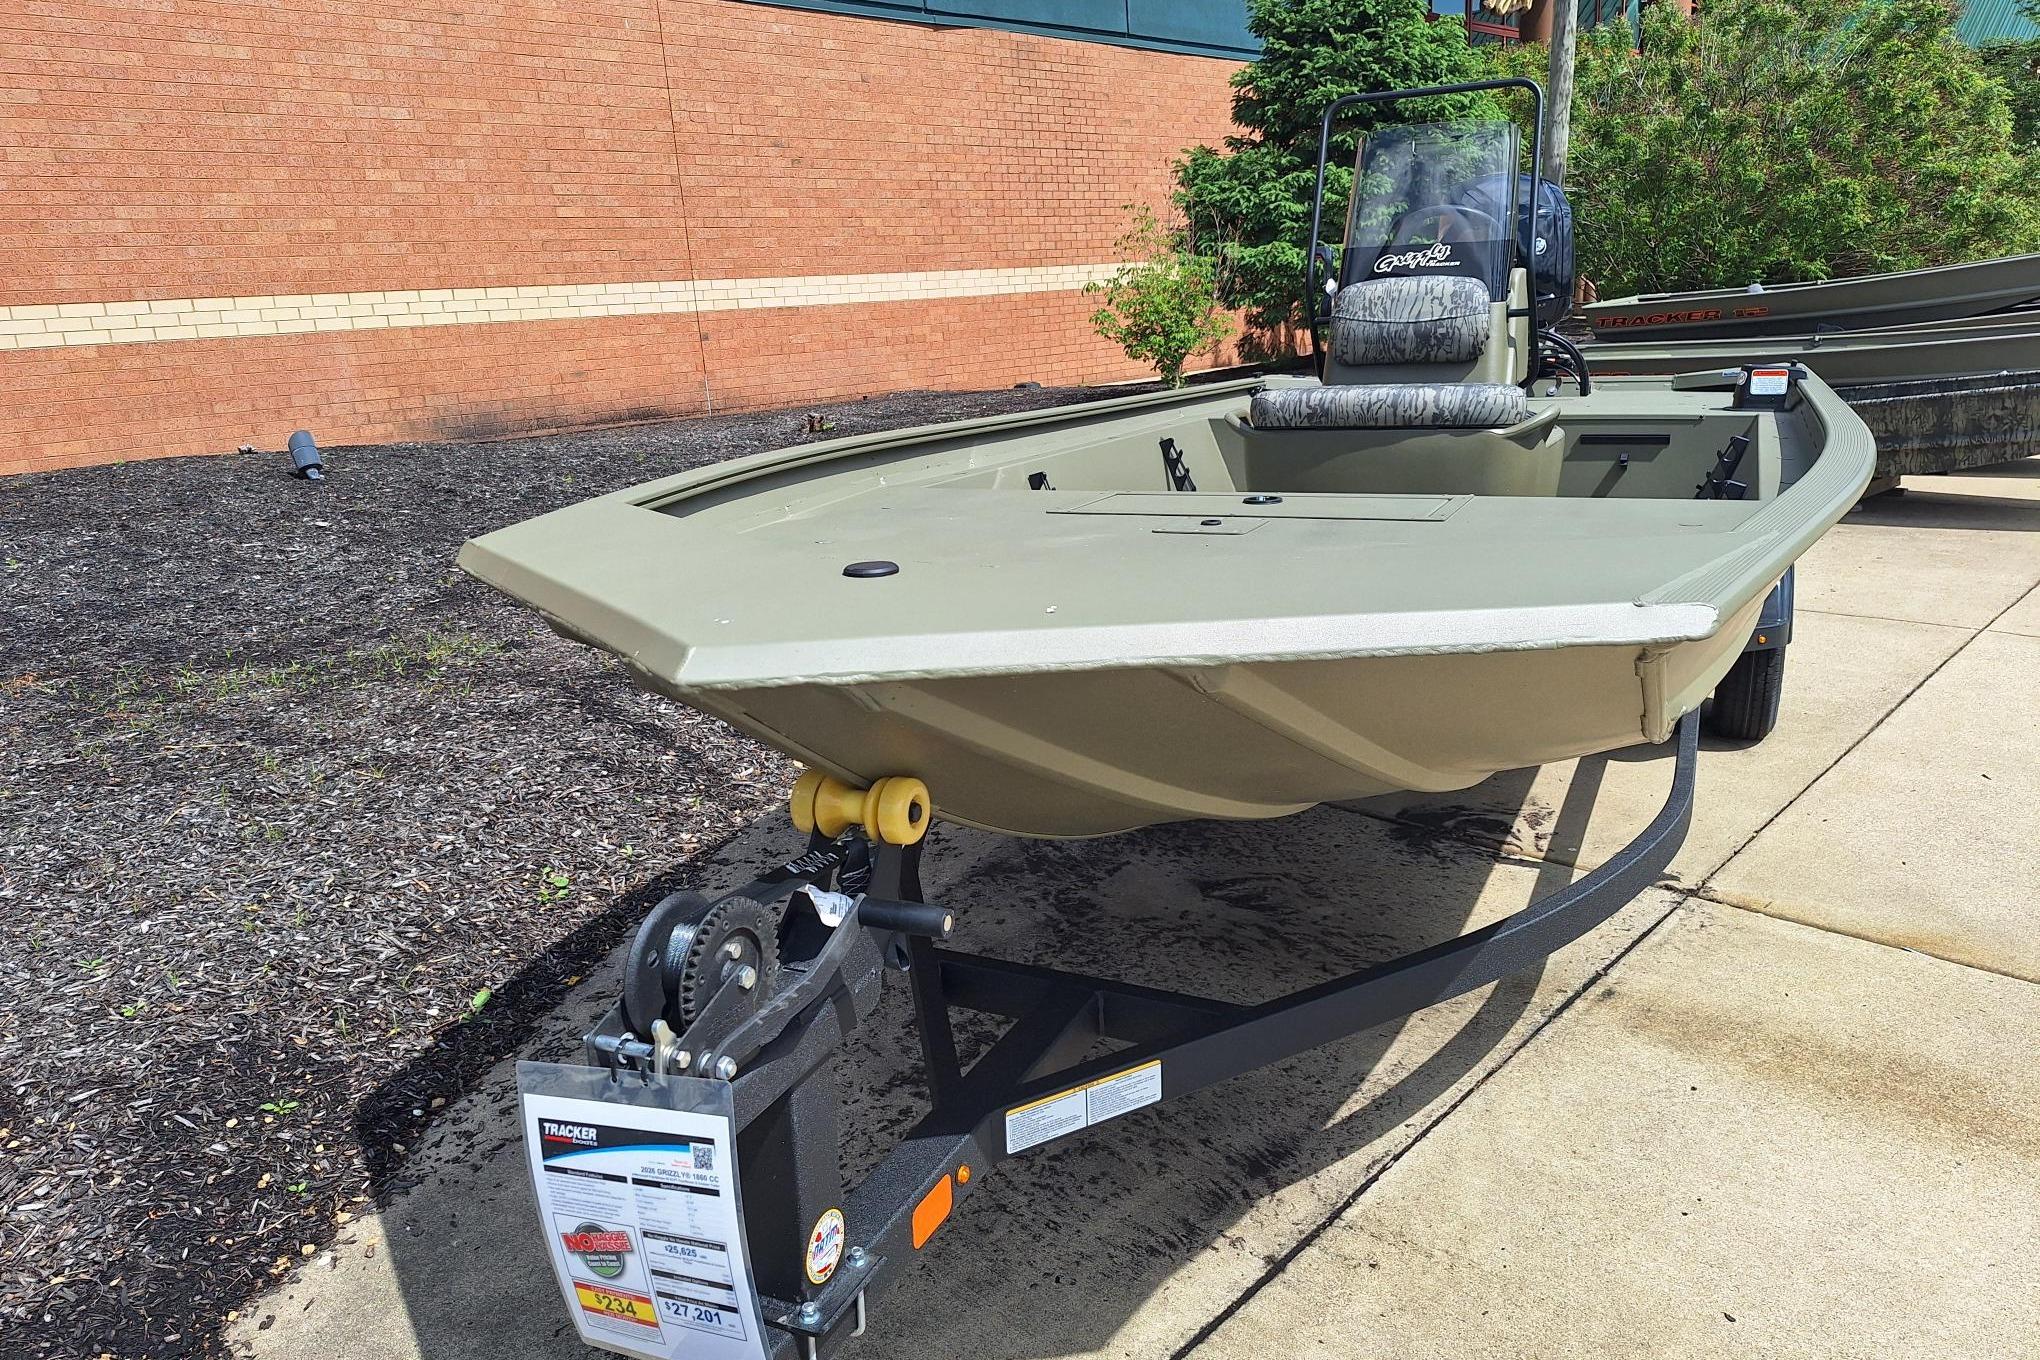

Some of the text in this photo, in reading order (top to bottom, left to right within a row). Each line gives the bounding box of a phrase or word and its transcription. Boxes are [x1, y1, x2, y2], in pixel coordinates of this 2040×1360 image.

[1596, 309, 1722, 328] TRACKER
[543, 1122, 597, 1140] TRACKER
[572, 1138, 598, 1147] boats
[709, 1175, 720, 1184] CC
[561, 1232, 595, 1253] NO
[590, 1231, 628, 1241] HAGGLE
[594, 1293, 637, 1317] $234
[664, 1301, 721, 1325] $27,201
